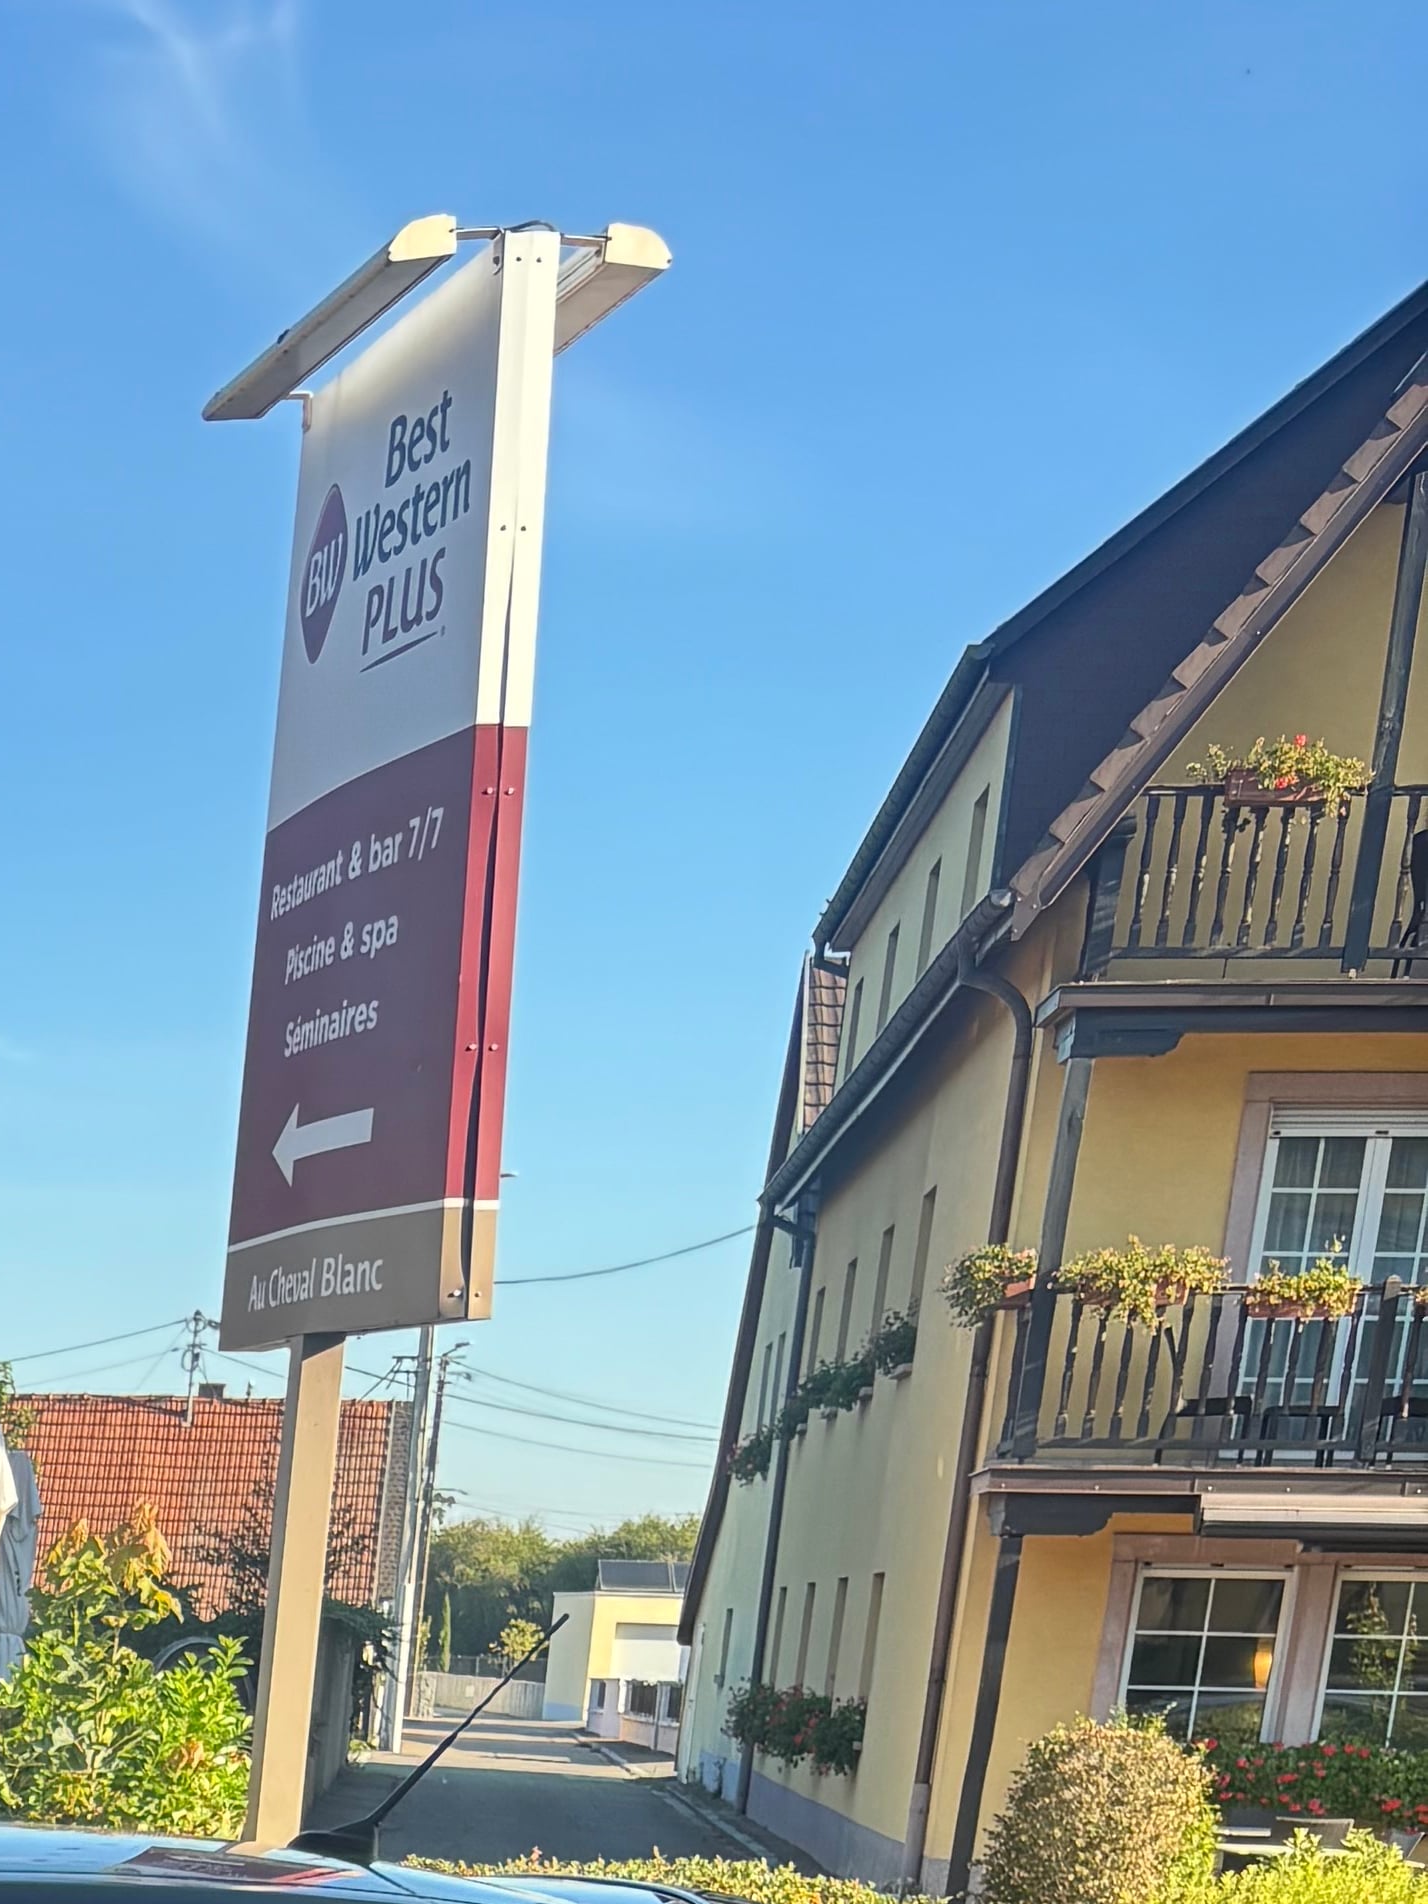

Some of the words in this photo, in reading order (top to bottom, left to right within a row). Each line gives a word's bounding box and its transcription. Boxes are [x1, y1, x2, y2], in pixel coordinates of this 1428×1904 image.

[384, 389, 453, 489] Best
[352, 458, 472, 582] Western
[305, 532, 344, 618] BW
[361, 546, 447, 657] PLUS
[270, 849, 344, 921] Restaurant
[347, 840, 363, 880] &
[368, 833, 403, 873] bar
[408, 806, 445, 861] 7/7
[284, 934, 336, 986] Piscine
[340, 921, 355, 960] &
[359, 914, 399, 959] spa
[284, 999, 380, 1058] Séminaires
[247, 1274, 267, 1313] Au
[268, 1257, 317, 1308] Cheval
[320, 1252, 384, 1297] Blanc
